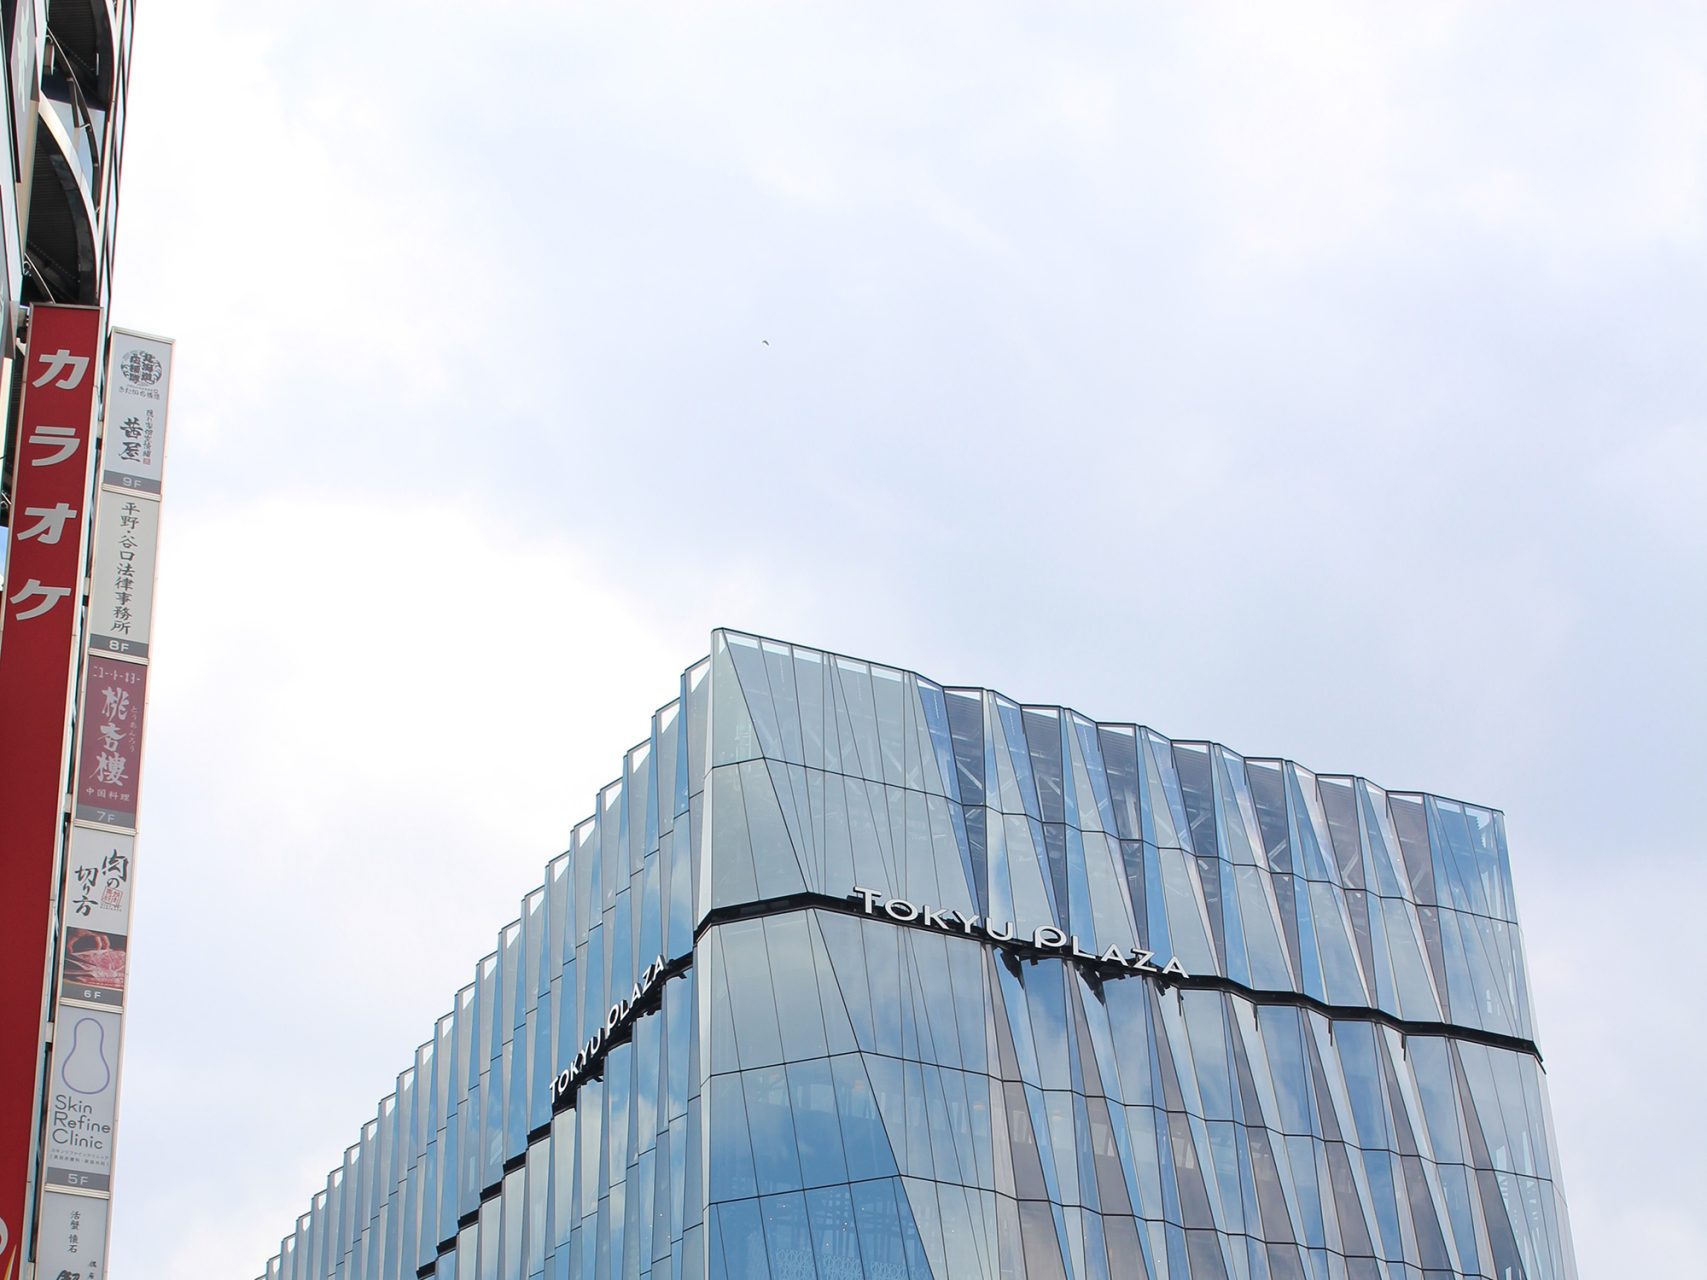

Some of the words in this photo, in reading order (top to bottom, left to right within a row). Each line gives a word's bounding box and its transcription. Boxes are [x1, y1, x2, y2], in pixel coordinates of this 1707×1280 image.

[119, 417, 143, 462] 茜屋
[10, 349, 90, 621] カラオケ
[122, 477, 141, 489] 9F
[110, 502, 140, 635] 平野・谷口法律事務所
[109, 639, 129, 652] 8F
[86, 787, 130, 801] 中国料理
[97, 811, 116, 823] 7F
[102, 849, 129, 889] 肉の
[72, 865, 98, 916] 切り方
[853, 886, 1014, 942] TOKYU
[1034, 924, 1190, 979] PLAZA
[84, 989, 102, 999] 6F
[549, 1027, 604, 1103] TOKYU
[605, 954, 668, 1040] PLAZA
[55, 1094, 92, 1114] Skin
[54, 1110, 111, 1133] Refine
[52, 1128, 103, 1149] Clinic
[68, 1173, 88, 1185] 5F
